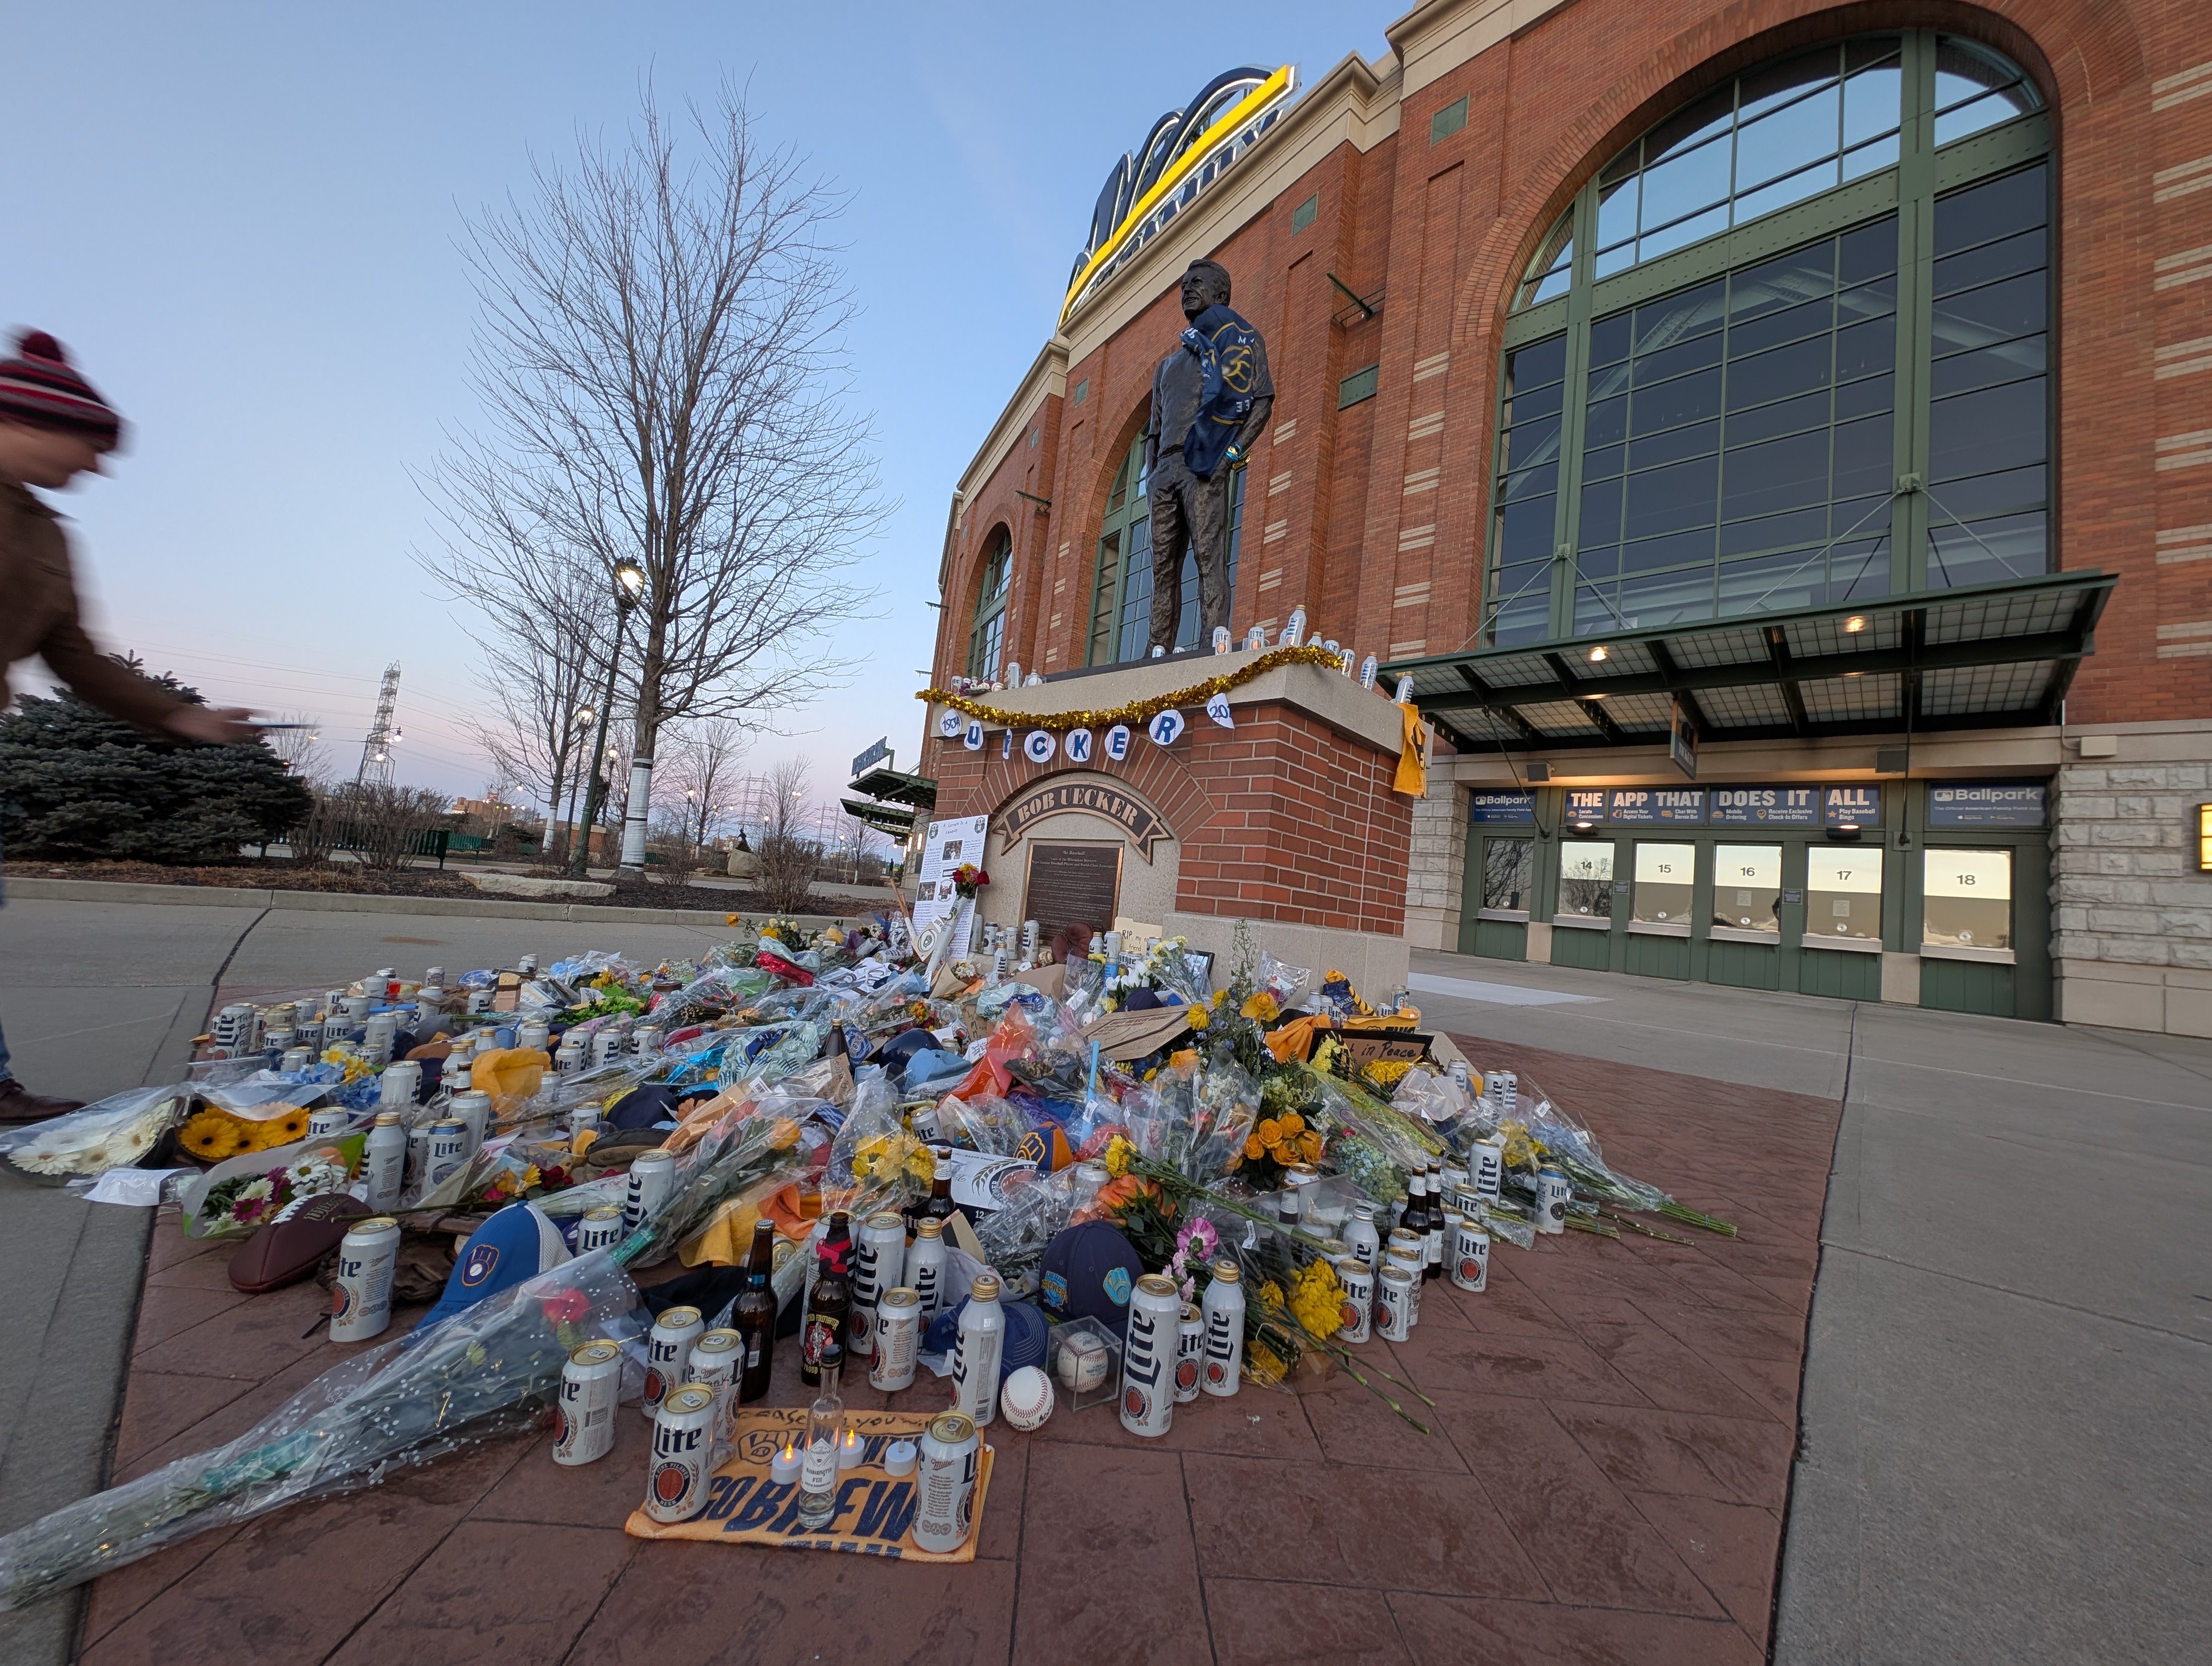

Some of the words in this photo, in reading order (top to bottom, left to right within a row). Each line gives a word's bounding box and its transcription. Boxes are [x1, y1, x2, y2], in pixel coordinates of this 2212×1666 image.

[1250, 630, 1263, 639] Lite
[1287, 617, 1297, 636] Lite
[942, 715, 960, 730] 1934
[1487, 795, 1531, 806] Ballpark
[1571, 792, 1603, 807] THE
[1613, 792, 1648, 806] APP
[1655, 791, 1703, 806] THAT
[1719, 790, 1776, 806] DOES
[1787, 790, 1810, 806] IT
[1828, 789, 1869, 806] ALL
[1956, 788, 2038, 803] Ballpark
[1017, 792, 1054, 824] BOB
[1060, 788, 1138, 826] UECKER
[1581, 861, 1592, 870] 14
[1658, 864, 1671, 873] 15
[1740, 867, 1756, 877] 16
[1836, 870, 1852, 880] 17
[1956, 874, 1976, 885] 18
[1022, 927, 1031, 949] Lite
[1129, 943, 1141, 951] friend
[998, 956, 1007, 975] Lite
[1328, 1005, 1341, 1017] Lite
[1381, 1008, 1392, 1016] Lit
[216, 1015, 239, 1048] Lite
[296, 1028, 318, 1040] Lite
[326, 1027, 349, 1039] Lite
[265, 1036, 279, 1047] ite
[1361, 1043, 1375, 1056] in
[1378, 1040, 1417, 1060] Peace
[603, 1041, 620, 1066] ite
[1504, 1081, 1517, 1105] Lite
[434, 1142, 463, 1158] Lite
[1477, 1156, 1498, 1196] Lite
[304, 1196, 348, 1221] Wilson
[584, 1227, 619, 1250] Lite
[1458, 1234, 1487, 1256] Lite
[1357, 1243, 1372, 1265] te
[340, 1257, 362, 1278] te
[852, 1242, 884, 1312] Lite
[915, 1267, 939, 1312] Lite
[1041, 1279, 1068, 1300] BREWERS
[816, 1313, 840, 1331] FIREFIGHTER
[876, 1310, 890, 1336] te
[895, 1317, 915, 1329] Miller
[1206, 1311, 1234, 1363] Lite
[1126, 1308, 1162, 1391] Lite
[652, 1368, 666, 1387] PILSNER
[701, 1367, 725, 1379] Miller
[803, 1363, 818, 1374] PROUD
[561, 1375, 581, 1402] te
[654, 1420, 703, 1459] Lite
[657, 1463, 669, 1475] FINE
[670, 1462, 689, 1481] PILSNER
[930, 1458, 955, 1471] Miller
[960, 1451, 979, 1485] Li
[659, 1499, 678, 1507] BEER
